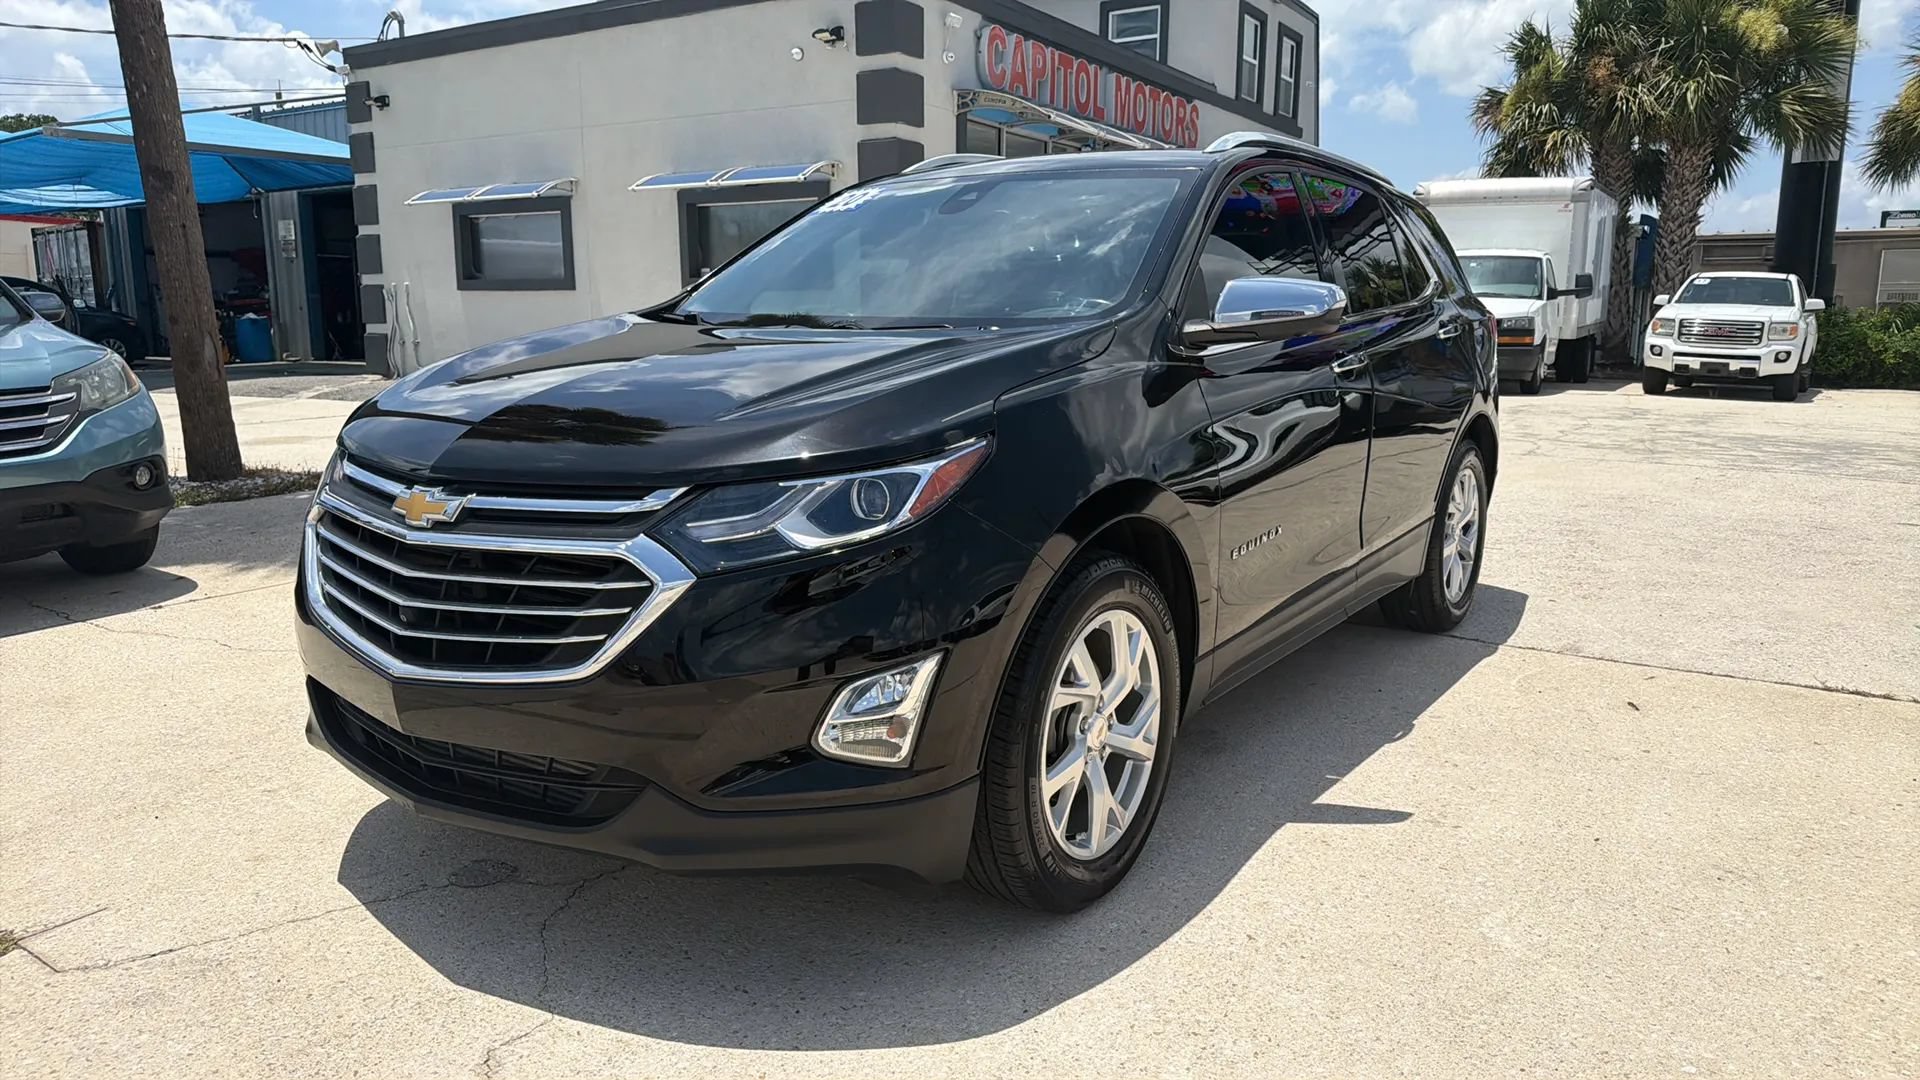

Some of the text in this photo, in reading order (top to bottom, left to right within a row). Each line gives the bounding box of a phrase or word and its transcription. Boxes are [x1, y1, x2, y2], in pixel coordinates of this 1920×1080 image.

[986, 24, 1200, 148] CAPITOL MOTORS
[1231, 524, 1283, 560] EQUINOX
[1140, 584, 1171, 631] MICHELIN
